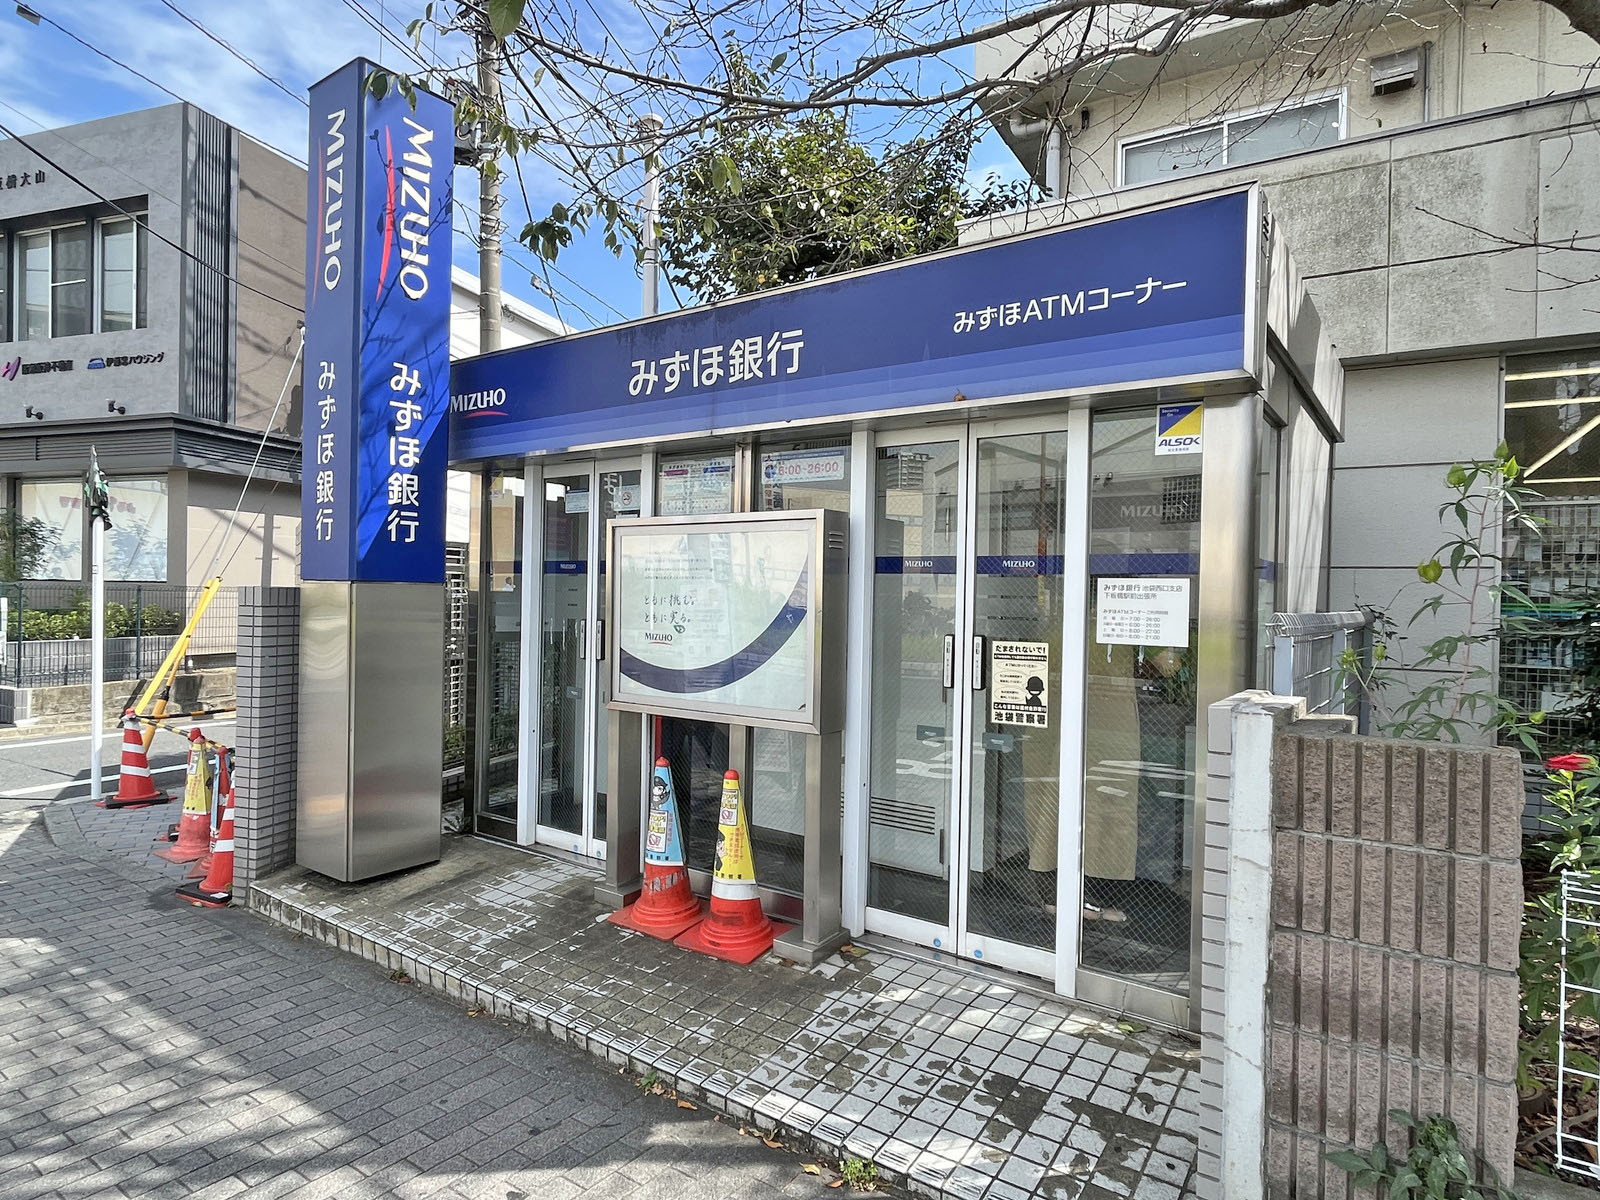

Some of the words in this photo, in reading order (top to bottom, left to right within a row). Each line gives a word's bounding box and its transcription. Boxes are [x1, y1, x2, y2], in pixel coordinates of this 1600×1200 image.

[0, 169, 46, 190] 橋大山
[324, 108, 346, 290] MIZUHO
[400, 116, 434, 300] MIZUHO
[952, 276, 1188, 334] みずほATMコーナー
[628, 328, 805, 397] みずほ銀行
[449, 387, 507, 414] MIZUHO
[315, 361, 337, 541] みずほ銀行
[387, 361, 423, 543] みずほ銀行
[1158, 436, 1201, 447] ALSOK
[904, 560, 933, 568] MIZUHO
[1002, 560, 1035, 568] MIZUHO
[1103, 584, 1140, 592] みずほ銀行
[644, 632, 673, 642] MIZUHO
[994, 711, 1046, 725] 池袋警察署
